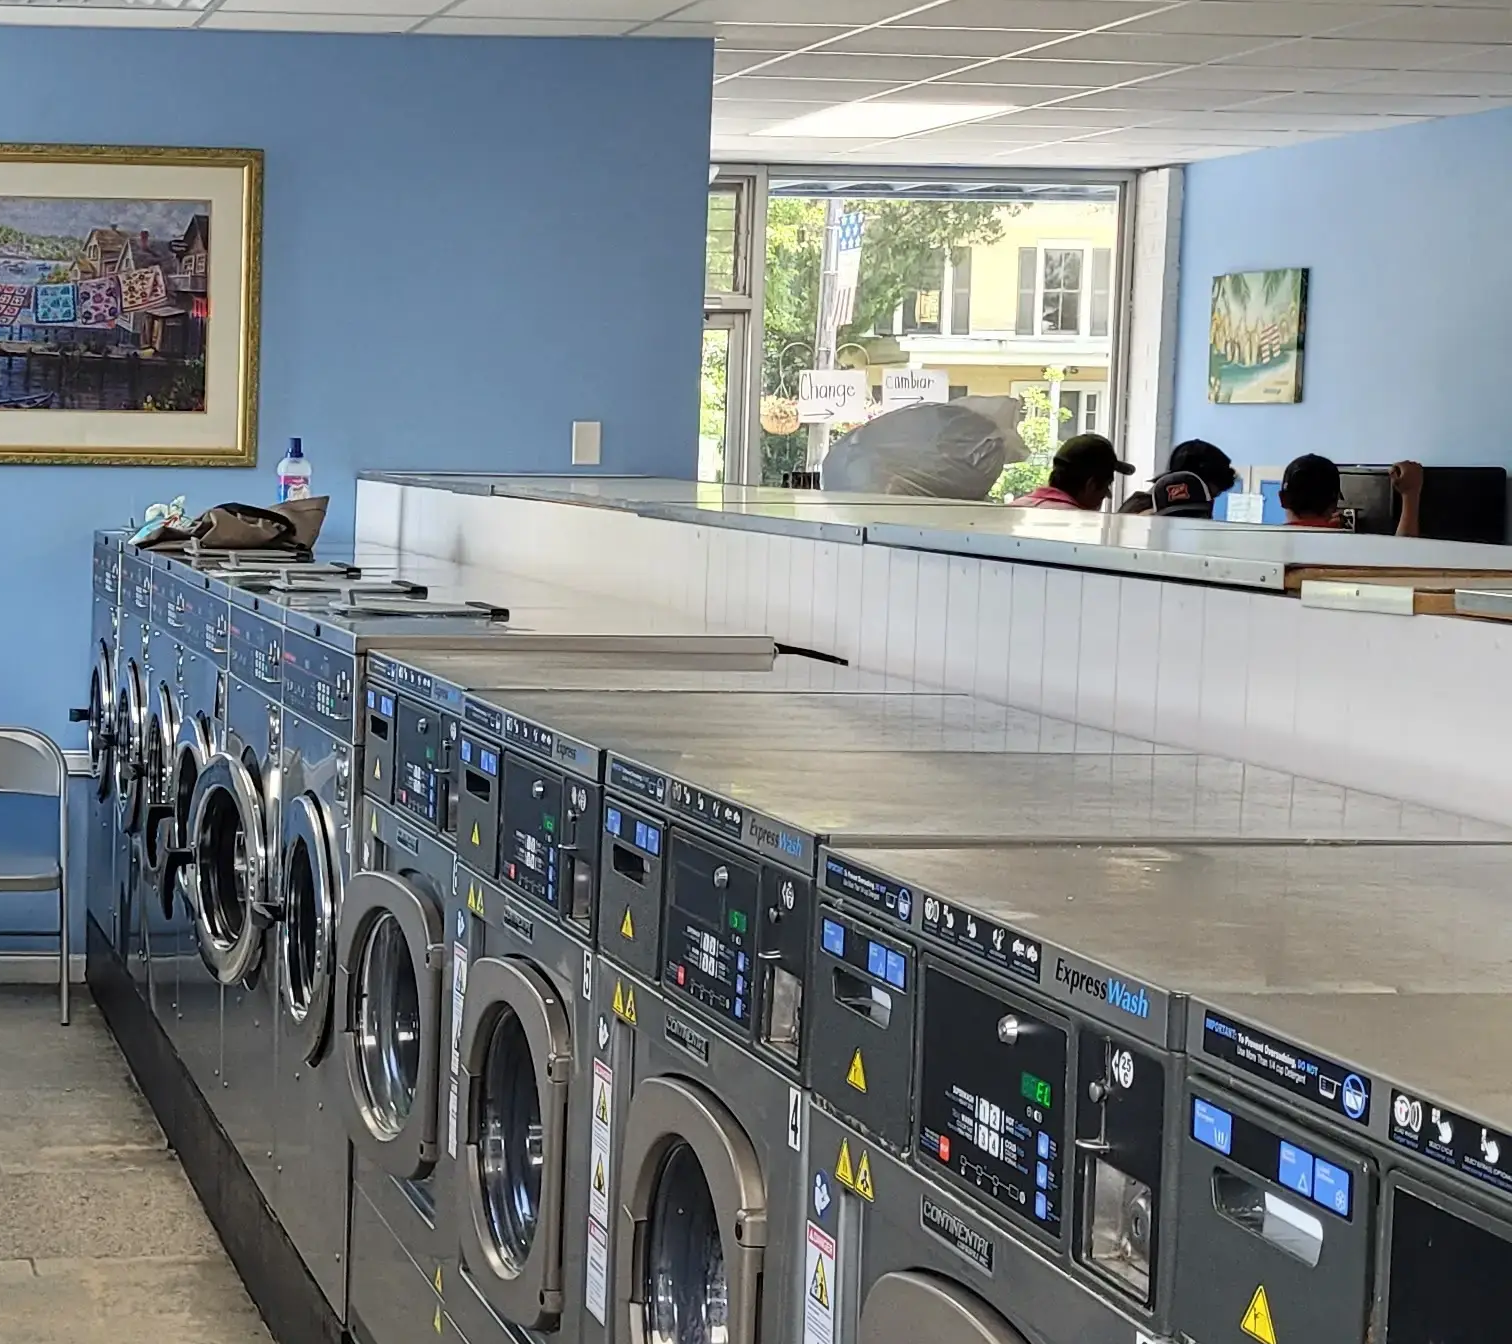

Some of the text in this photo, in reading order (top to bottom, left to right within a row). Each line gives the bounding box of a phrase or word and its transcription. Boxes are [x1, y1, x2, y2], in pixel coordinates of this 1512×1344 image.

[800, 373, 856, 407] Change
[885, 370, 935, 390] cambiar
[1055, 957, 1148, 1018] ExpressWash
[1122, 1056, 1132, 1073] 25
[791, 1094, 799, 1146] 4
[924, 1201, 989, 1258] CONTINENTAL
